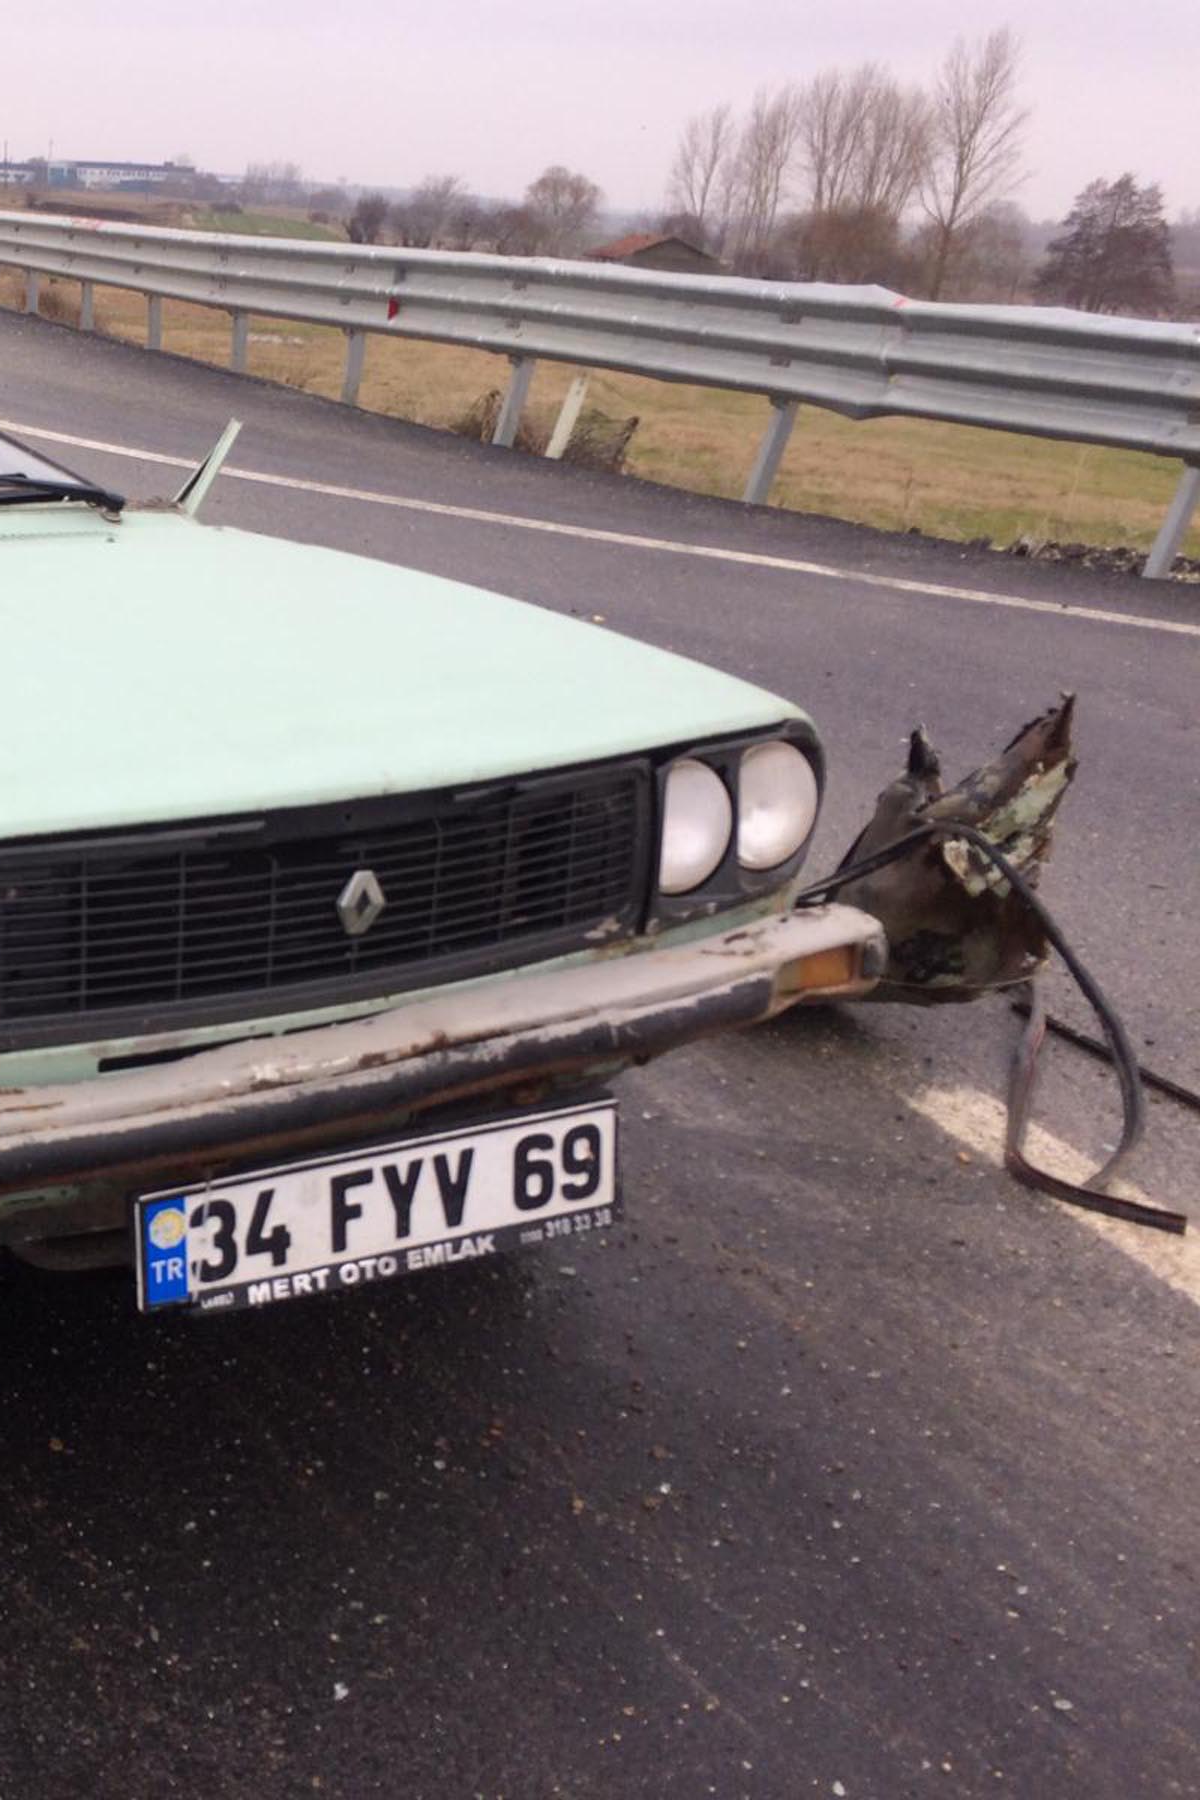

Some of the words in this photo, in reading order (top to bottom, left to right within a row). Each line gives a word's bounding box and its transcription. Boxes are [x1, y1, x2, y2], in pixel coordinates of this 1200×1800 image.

[189, 1189, 291, 1283] 34
[330, 1147, 474, 1253] FYV
[513, 1123, 601, 1211] 69
[150, 1257, 184, 1284] TR
[247, 1268, 330, 1305] MERT
[339, 1256, 397, 1285] OTO
[406, 1234, 496, 1271] EMLAK
